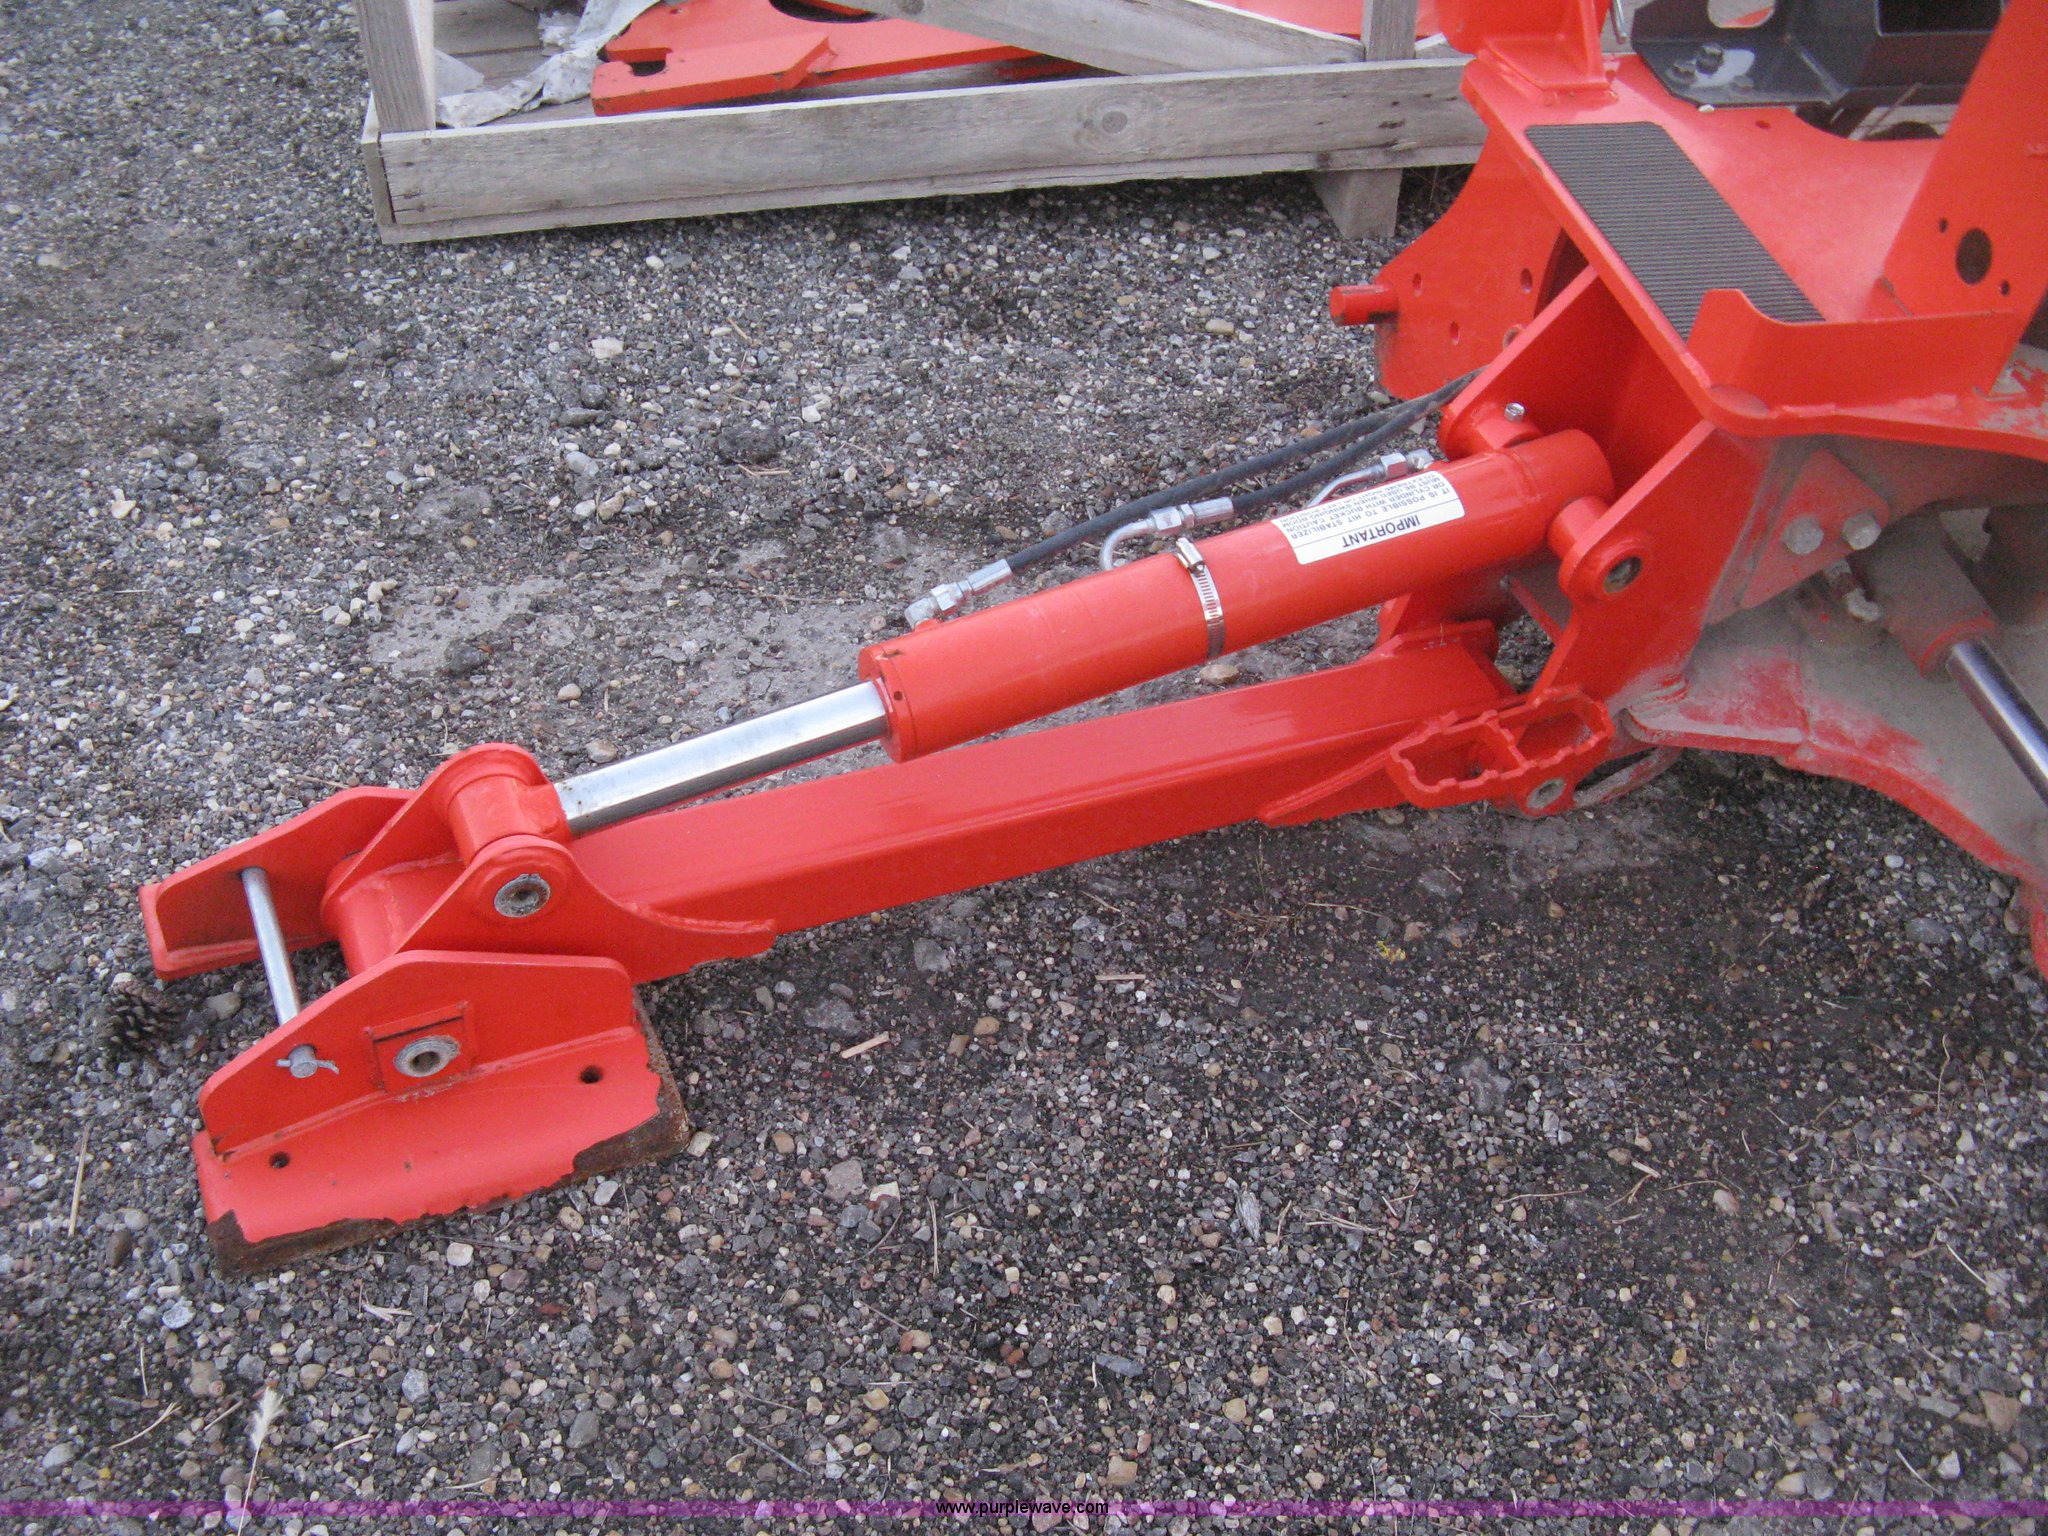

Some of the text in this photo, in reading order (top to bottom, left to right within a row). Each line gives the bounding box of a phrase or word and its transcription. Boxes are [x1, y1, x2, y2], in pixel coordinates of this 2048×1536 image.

[1388, 485, 1430, 502] CYLINDER
[1364, 498, 1386, 509] WITH
[1380, 494, 1425, 512] POSSIBLE
[1346, 513, 1361, 522] HIT
[1364, 508, 1377, 517] TO
[1290, 519, 1342, 539] STABILIZER
[1342, 514, 1421, 548] IMPORTANT
